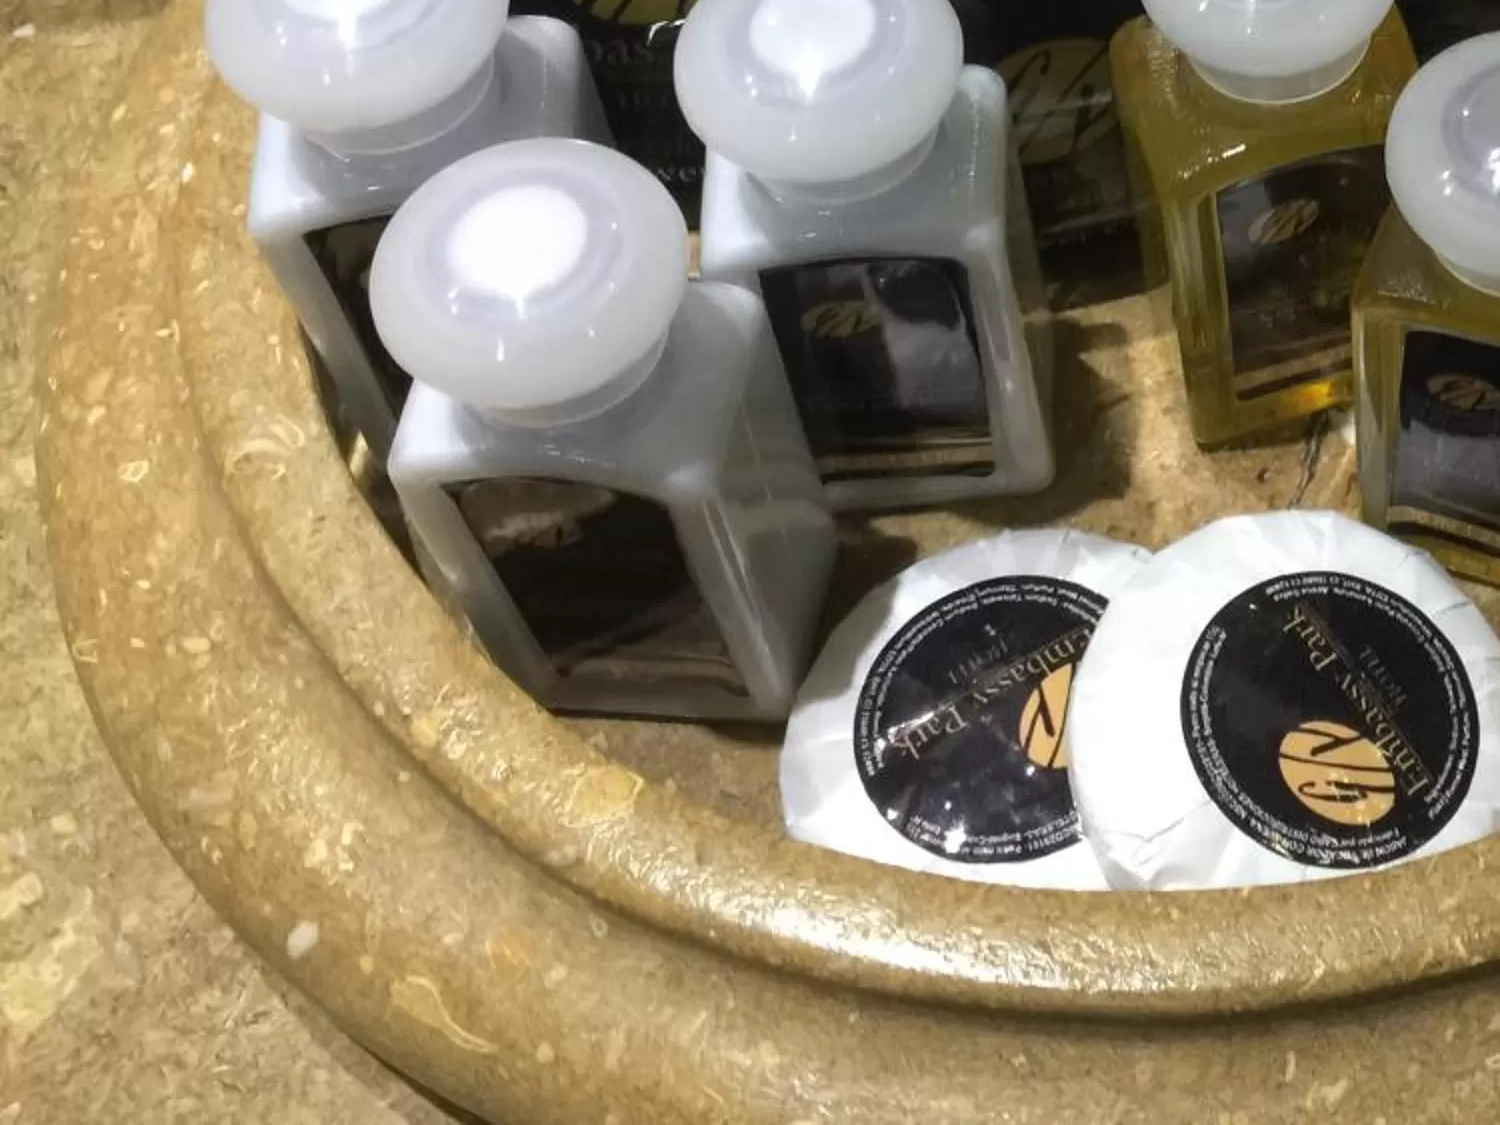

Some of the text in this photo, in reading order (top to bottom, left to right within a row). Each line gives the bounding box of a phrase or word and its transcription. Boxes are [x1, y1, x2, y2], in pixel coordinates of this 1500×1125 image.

[1283, 606, 1337, 672] Park
[891, 699, 968, 759] Park
[1334, 671, 1430, 796] Embassy
